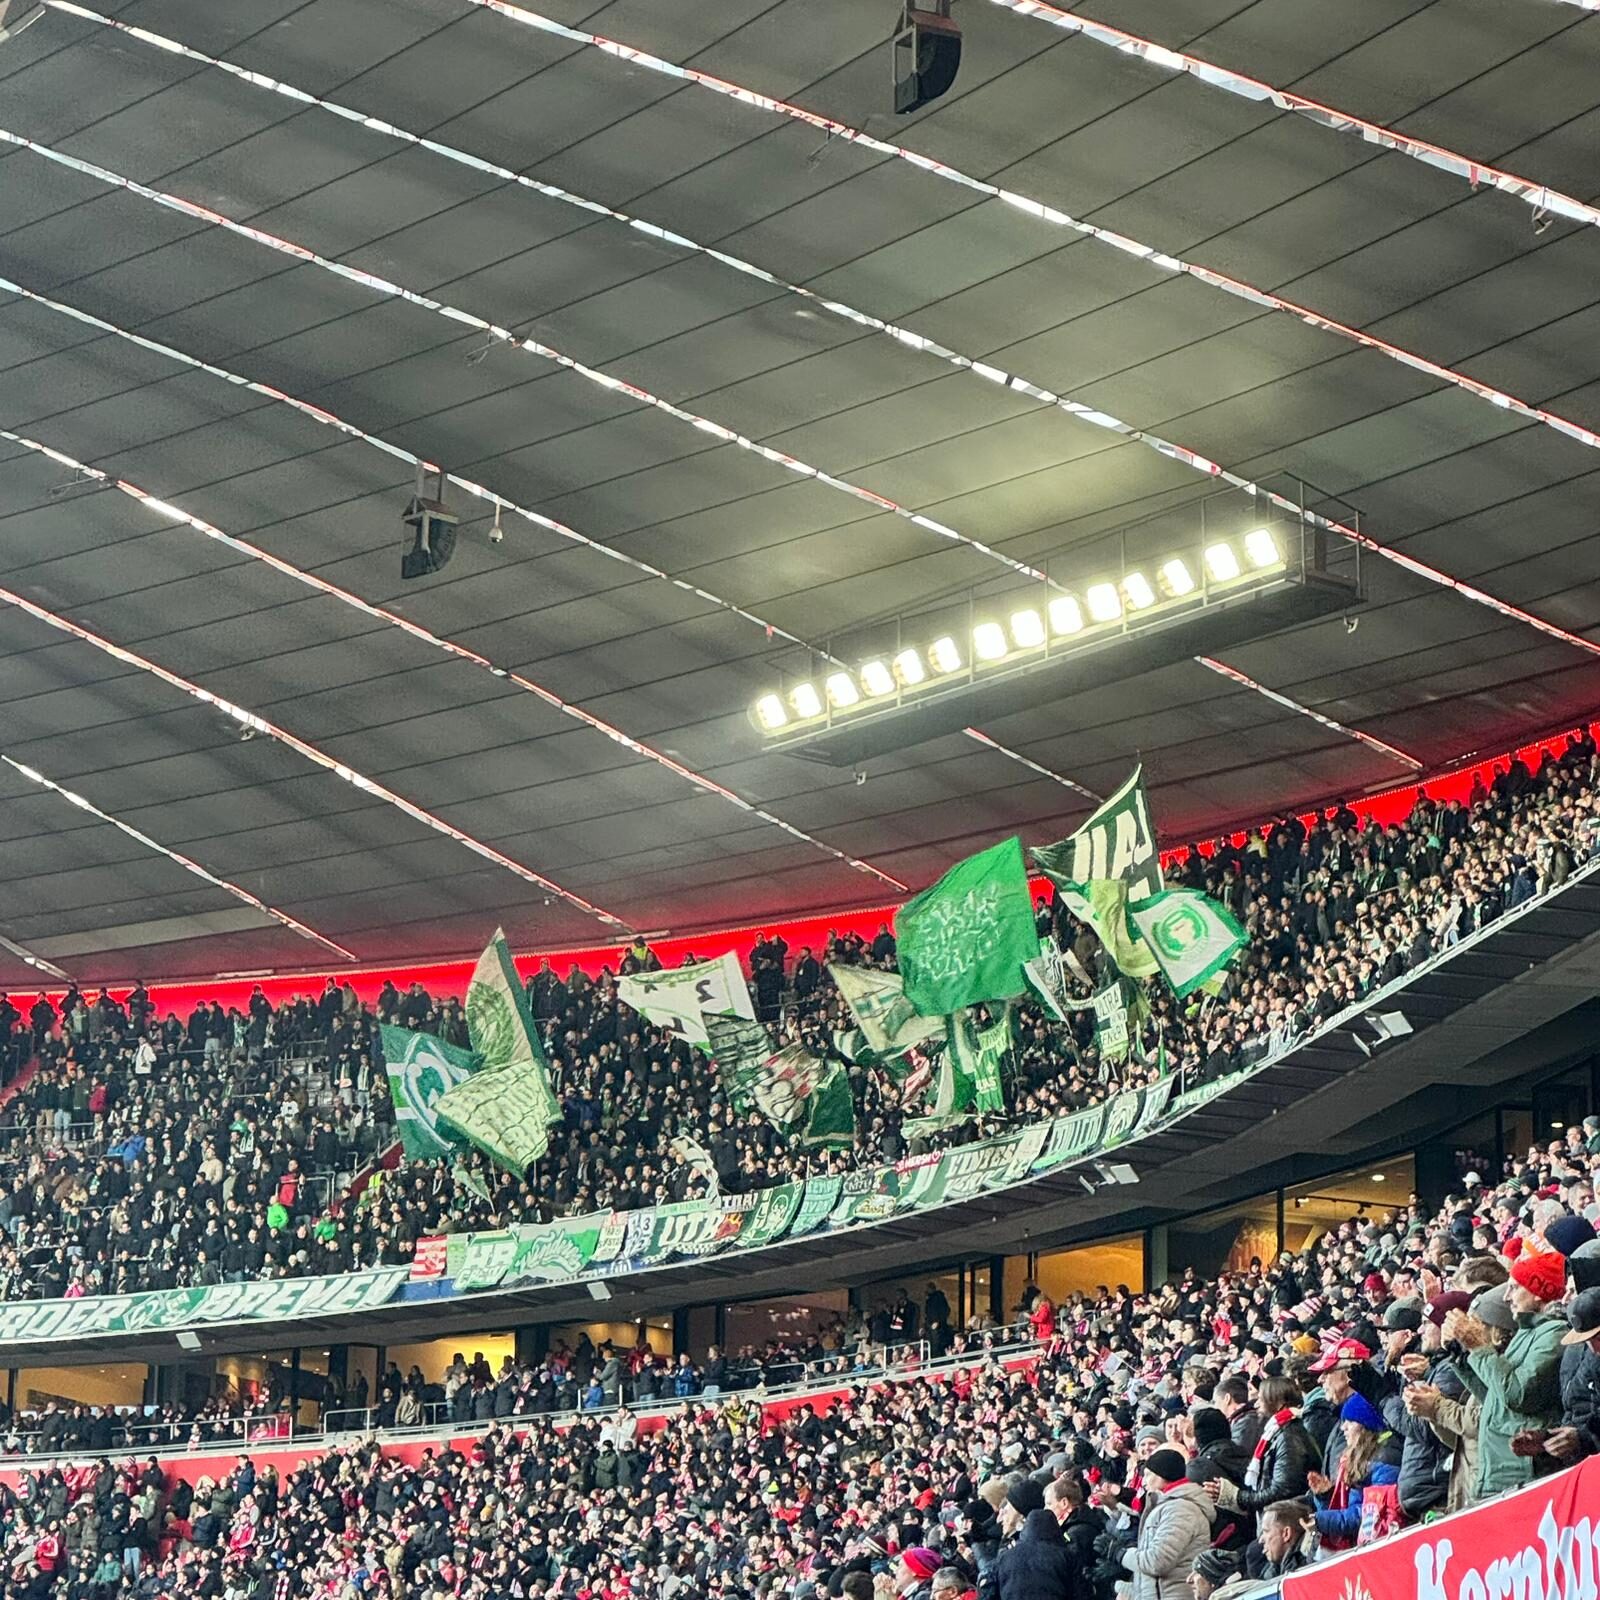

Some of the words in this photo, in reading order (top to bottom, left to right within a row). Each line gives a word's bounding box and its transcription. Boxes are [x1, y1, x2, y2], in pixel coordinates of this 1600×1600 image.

[658, 1210, 726, 1247] UTB
[0, 1297, 133, 1340] RDER
[192, 1270, 408, 1319] BREMEN
